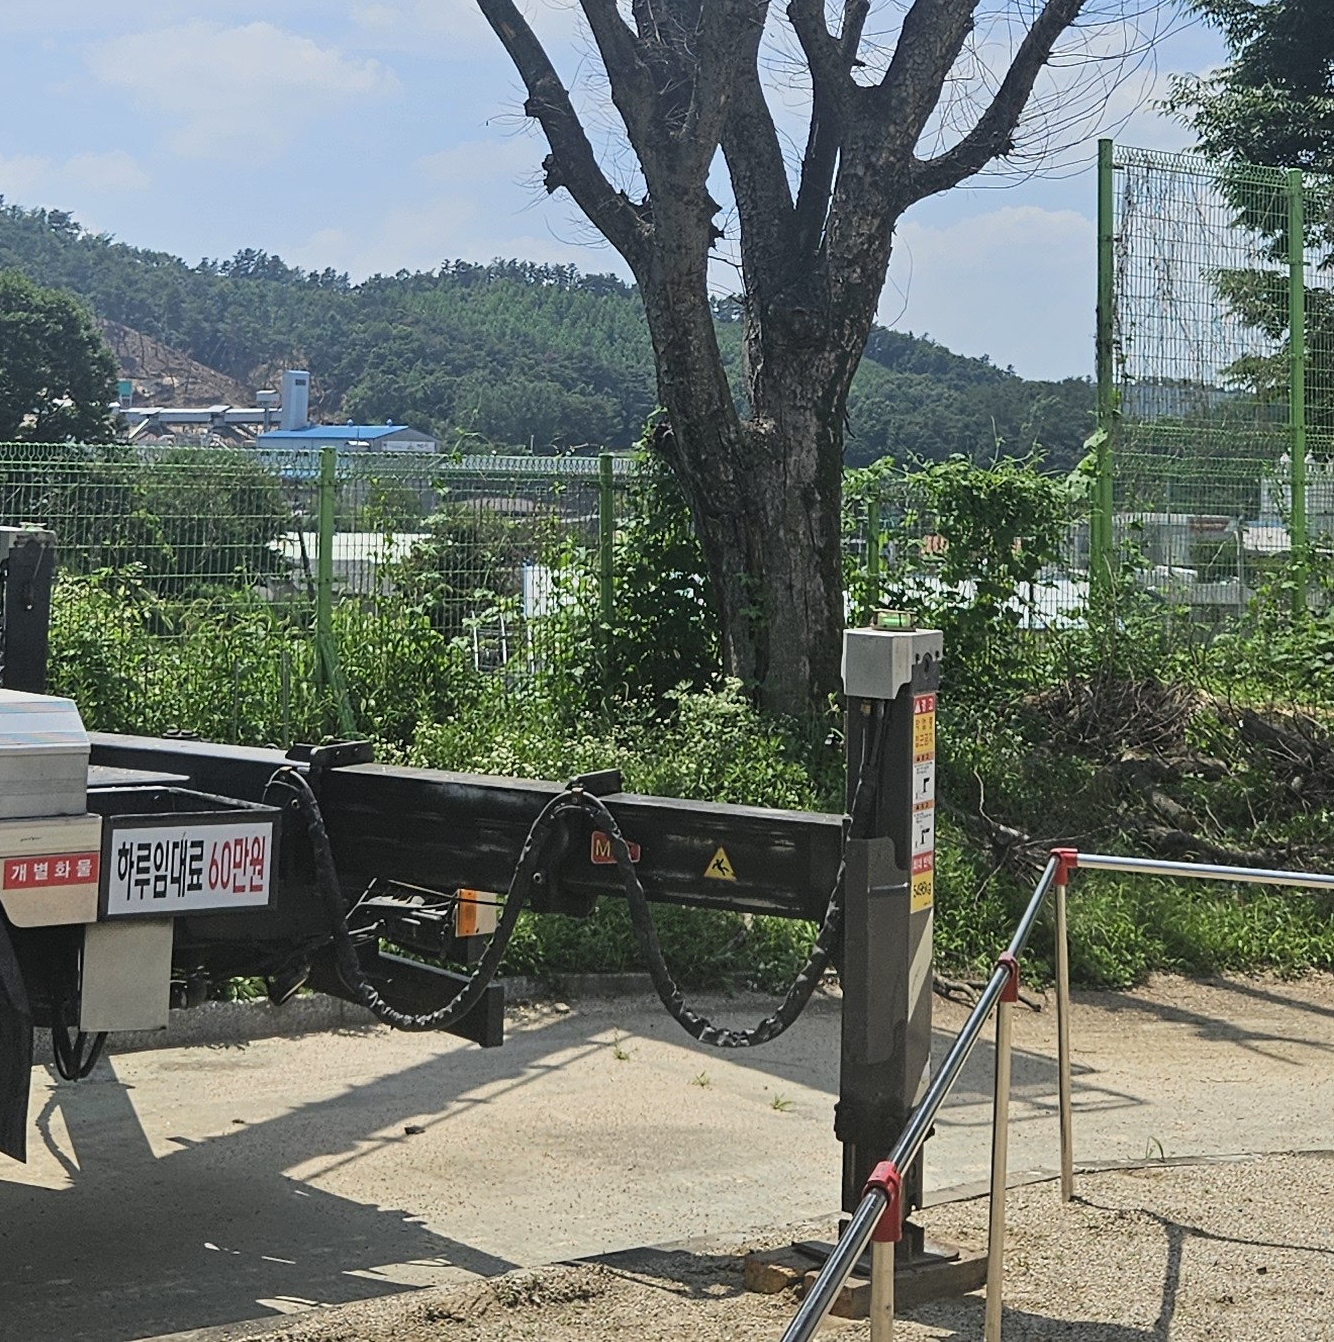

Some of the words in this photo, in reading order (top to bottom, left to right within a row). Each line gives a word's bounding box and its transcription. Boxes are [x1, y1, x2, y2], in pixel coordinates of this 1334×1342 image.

[595, 839, 611, 857] M
[10, 858, 93, 881] 개별화물
[117, 838, 204, 901] 하루임대료
[208, 835, 266, 893] 60만원
